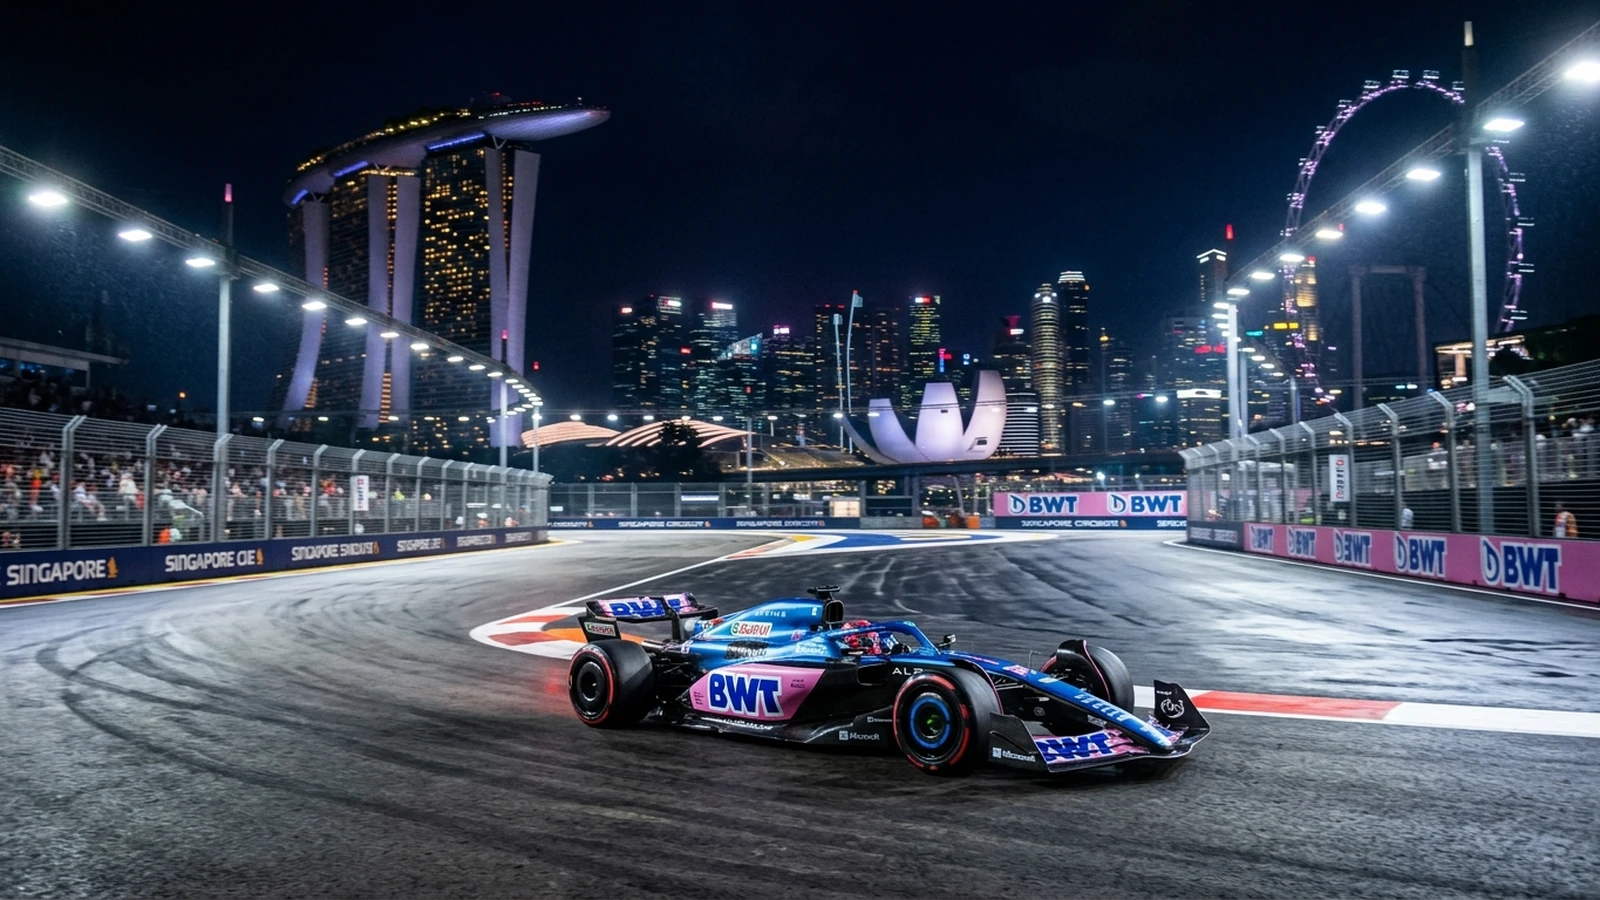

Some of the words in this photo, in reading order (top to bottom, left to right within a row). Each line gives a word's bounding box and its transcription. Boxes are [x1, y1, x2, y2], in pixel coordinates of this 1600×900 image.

[1029, 495, 1078, 513] BWT
[1130, 495, 1182, 513] BWT
[165, 551, 235, 572] SINGAPORE
[1344, 532, 1371, 565] BWT
[1408, 537, 1446, 575] BWT
[6, 559, 107, 586] SINGAPORE
[1502, 543, 1560, 592] BWT
[709, 672, 781, 714] BWT
